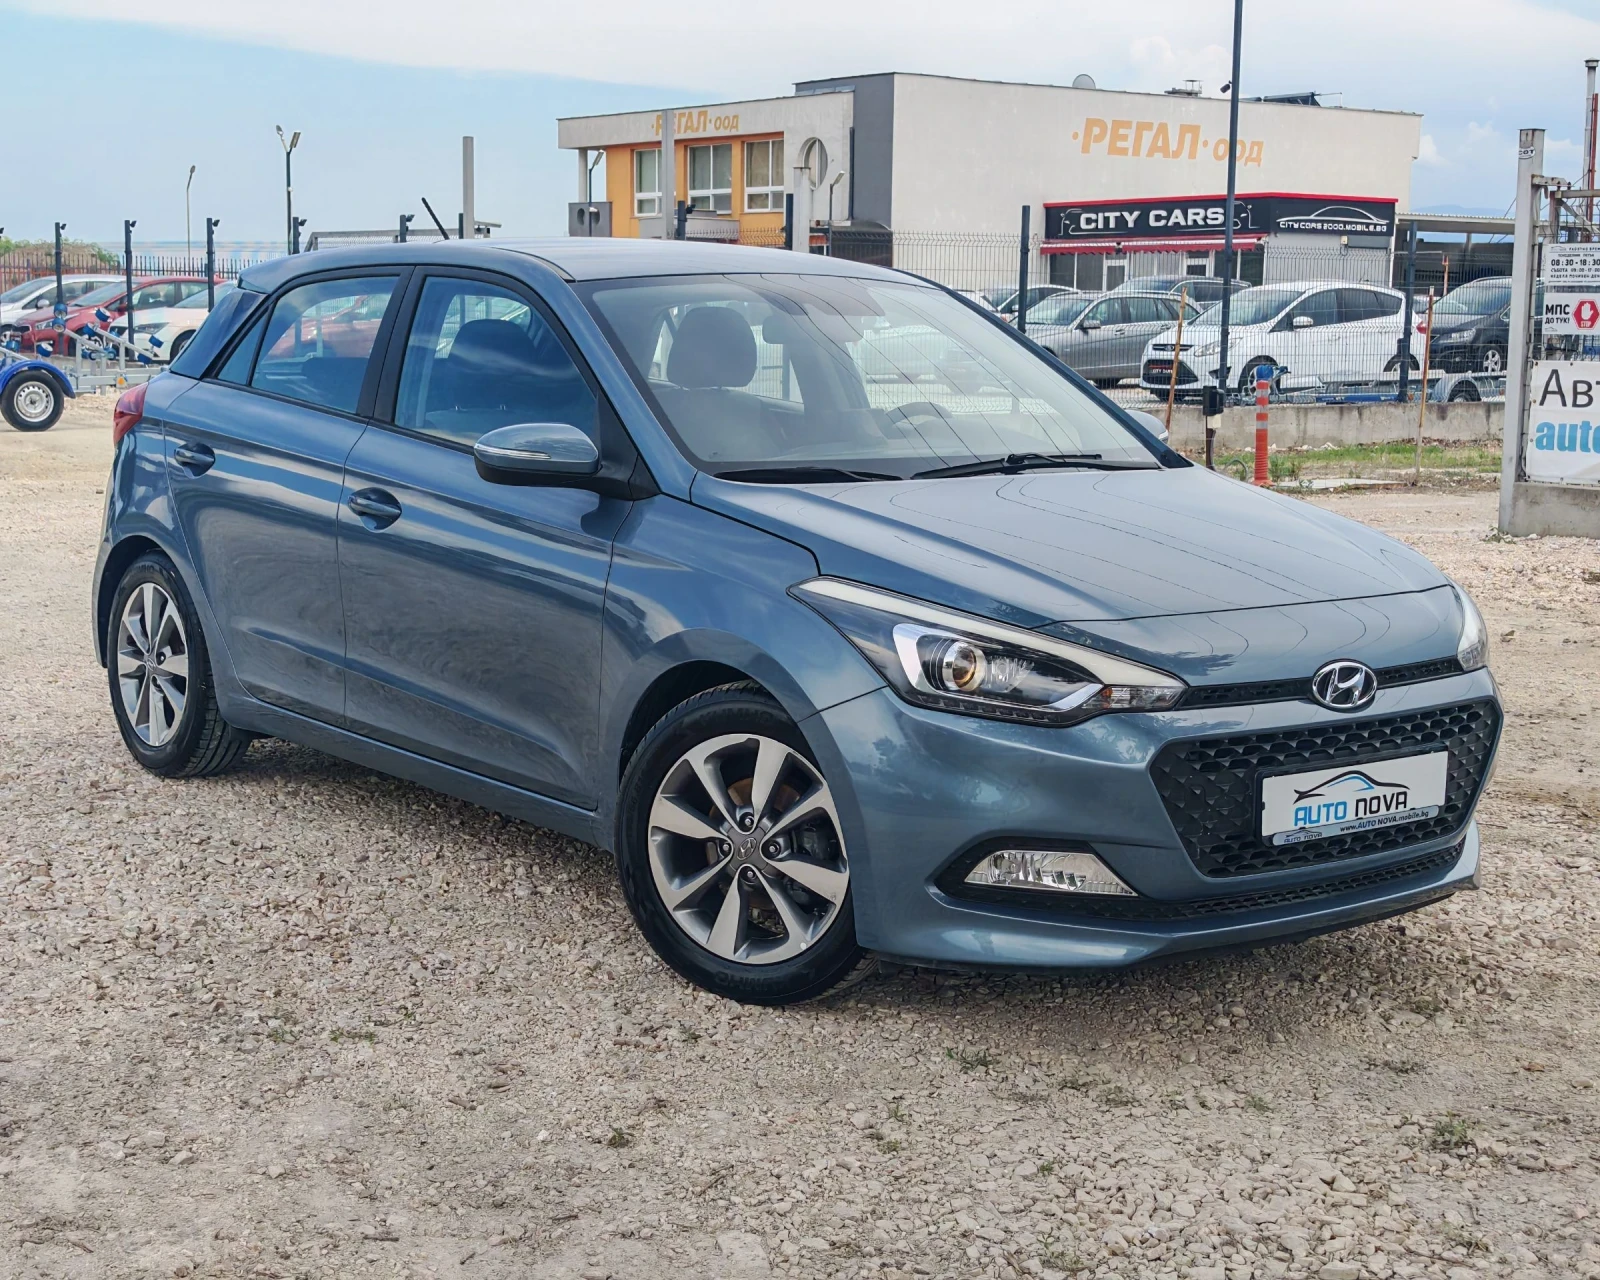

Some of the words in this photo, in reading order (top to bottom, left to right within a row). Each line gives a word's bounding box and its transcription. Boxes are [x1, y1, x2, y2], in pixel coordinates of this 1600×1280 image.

[655, 110, 708, 136] РГАЛ
[1081, 117, 1201, 160] РЕГАЛ
[1079, 210, 1141, 230] CITY
[1148, 207, 1225, 228] CARS
[1545, 303, 1570, 316] МПС
[1293, 801, 1348, 826] AUTO
[1354, 791, 1408, 817] NOVA
